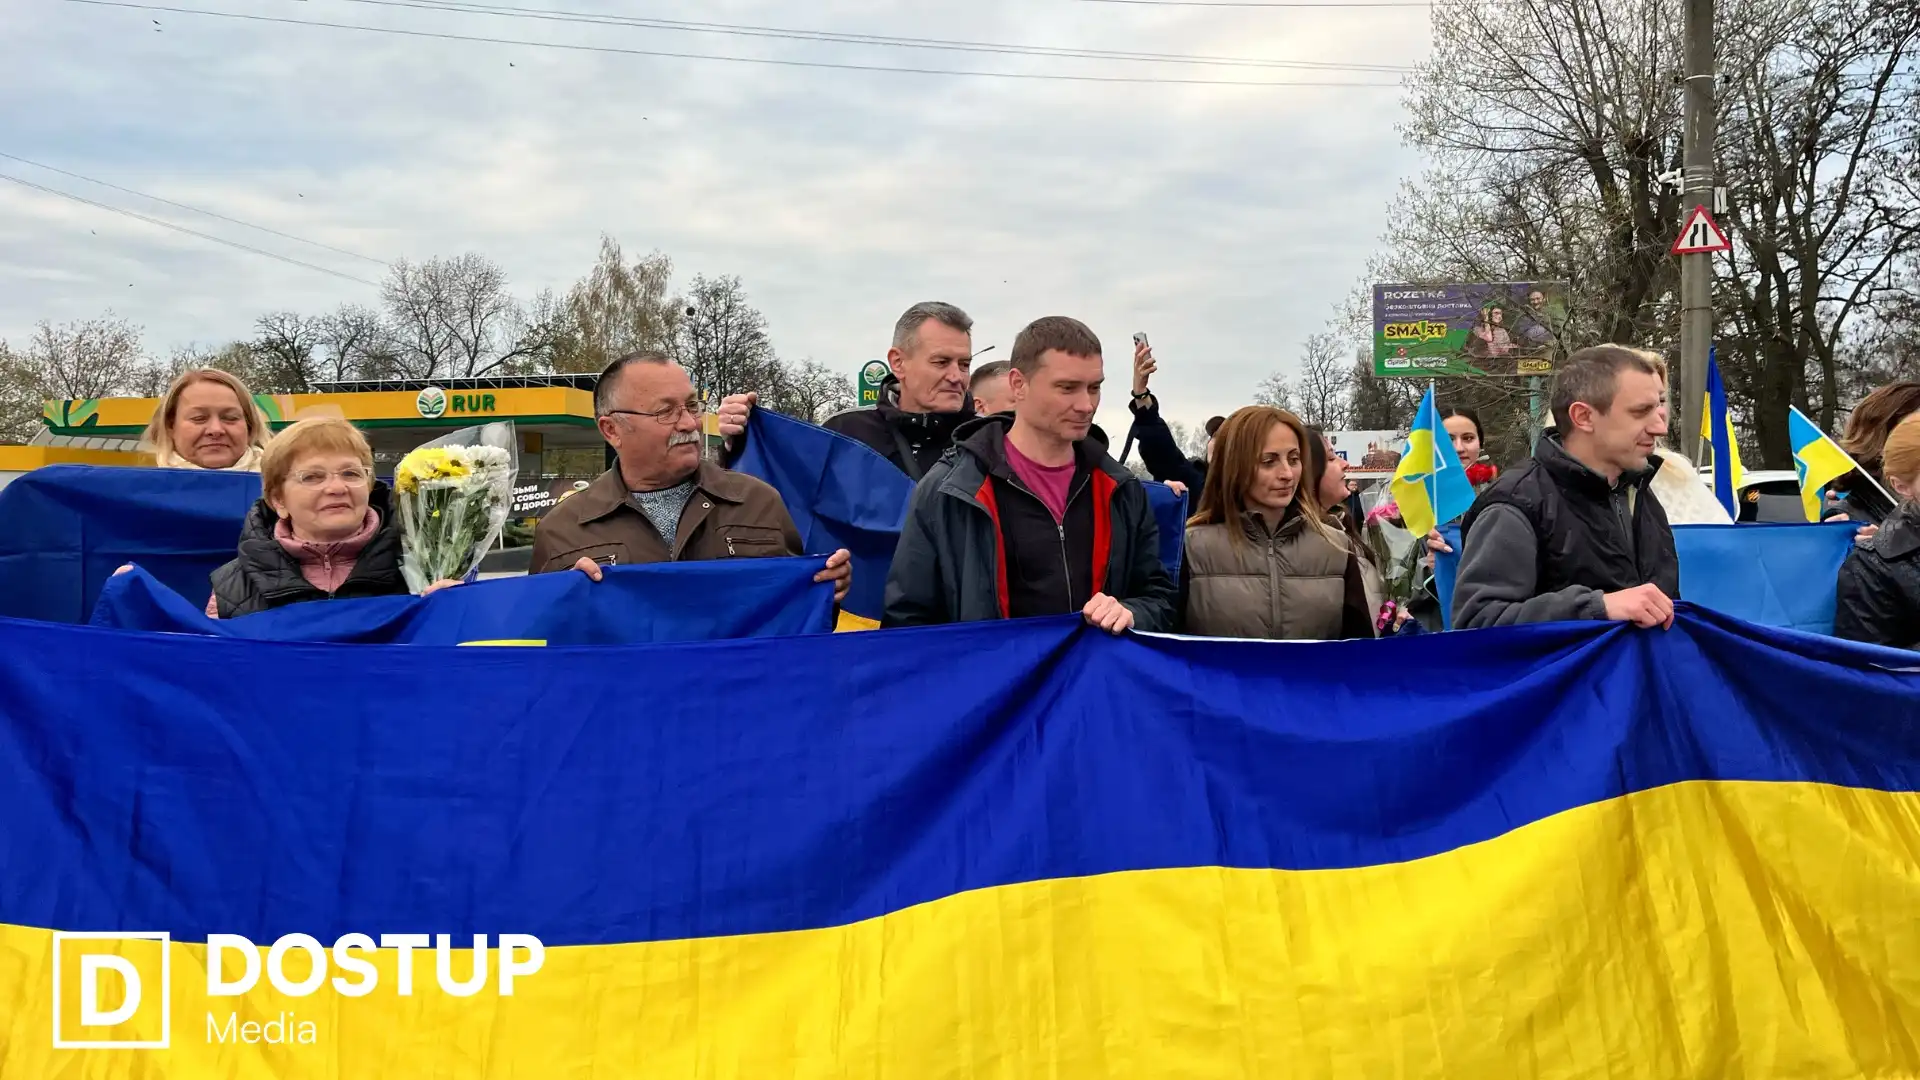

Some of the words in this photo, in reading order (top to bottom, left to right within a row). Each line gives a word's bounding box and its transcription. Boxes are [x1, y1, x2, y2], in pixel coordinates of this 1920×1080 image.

[1383, 290, 1446, 300] ROZETKA
[863, 390, 880, 401] RU
[452, 394, 496, 412] RUR
[516, 491, 550, 503] СОБОЮ
[521, 498, 557, 511] ДОРОГУ
